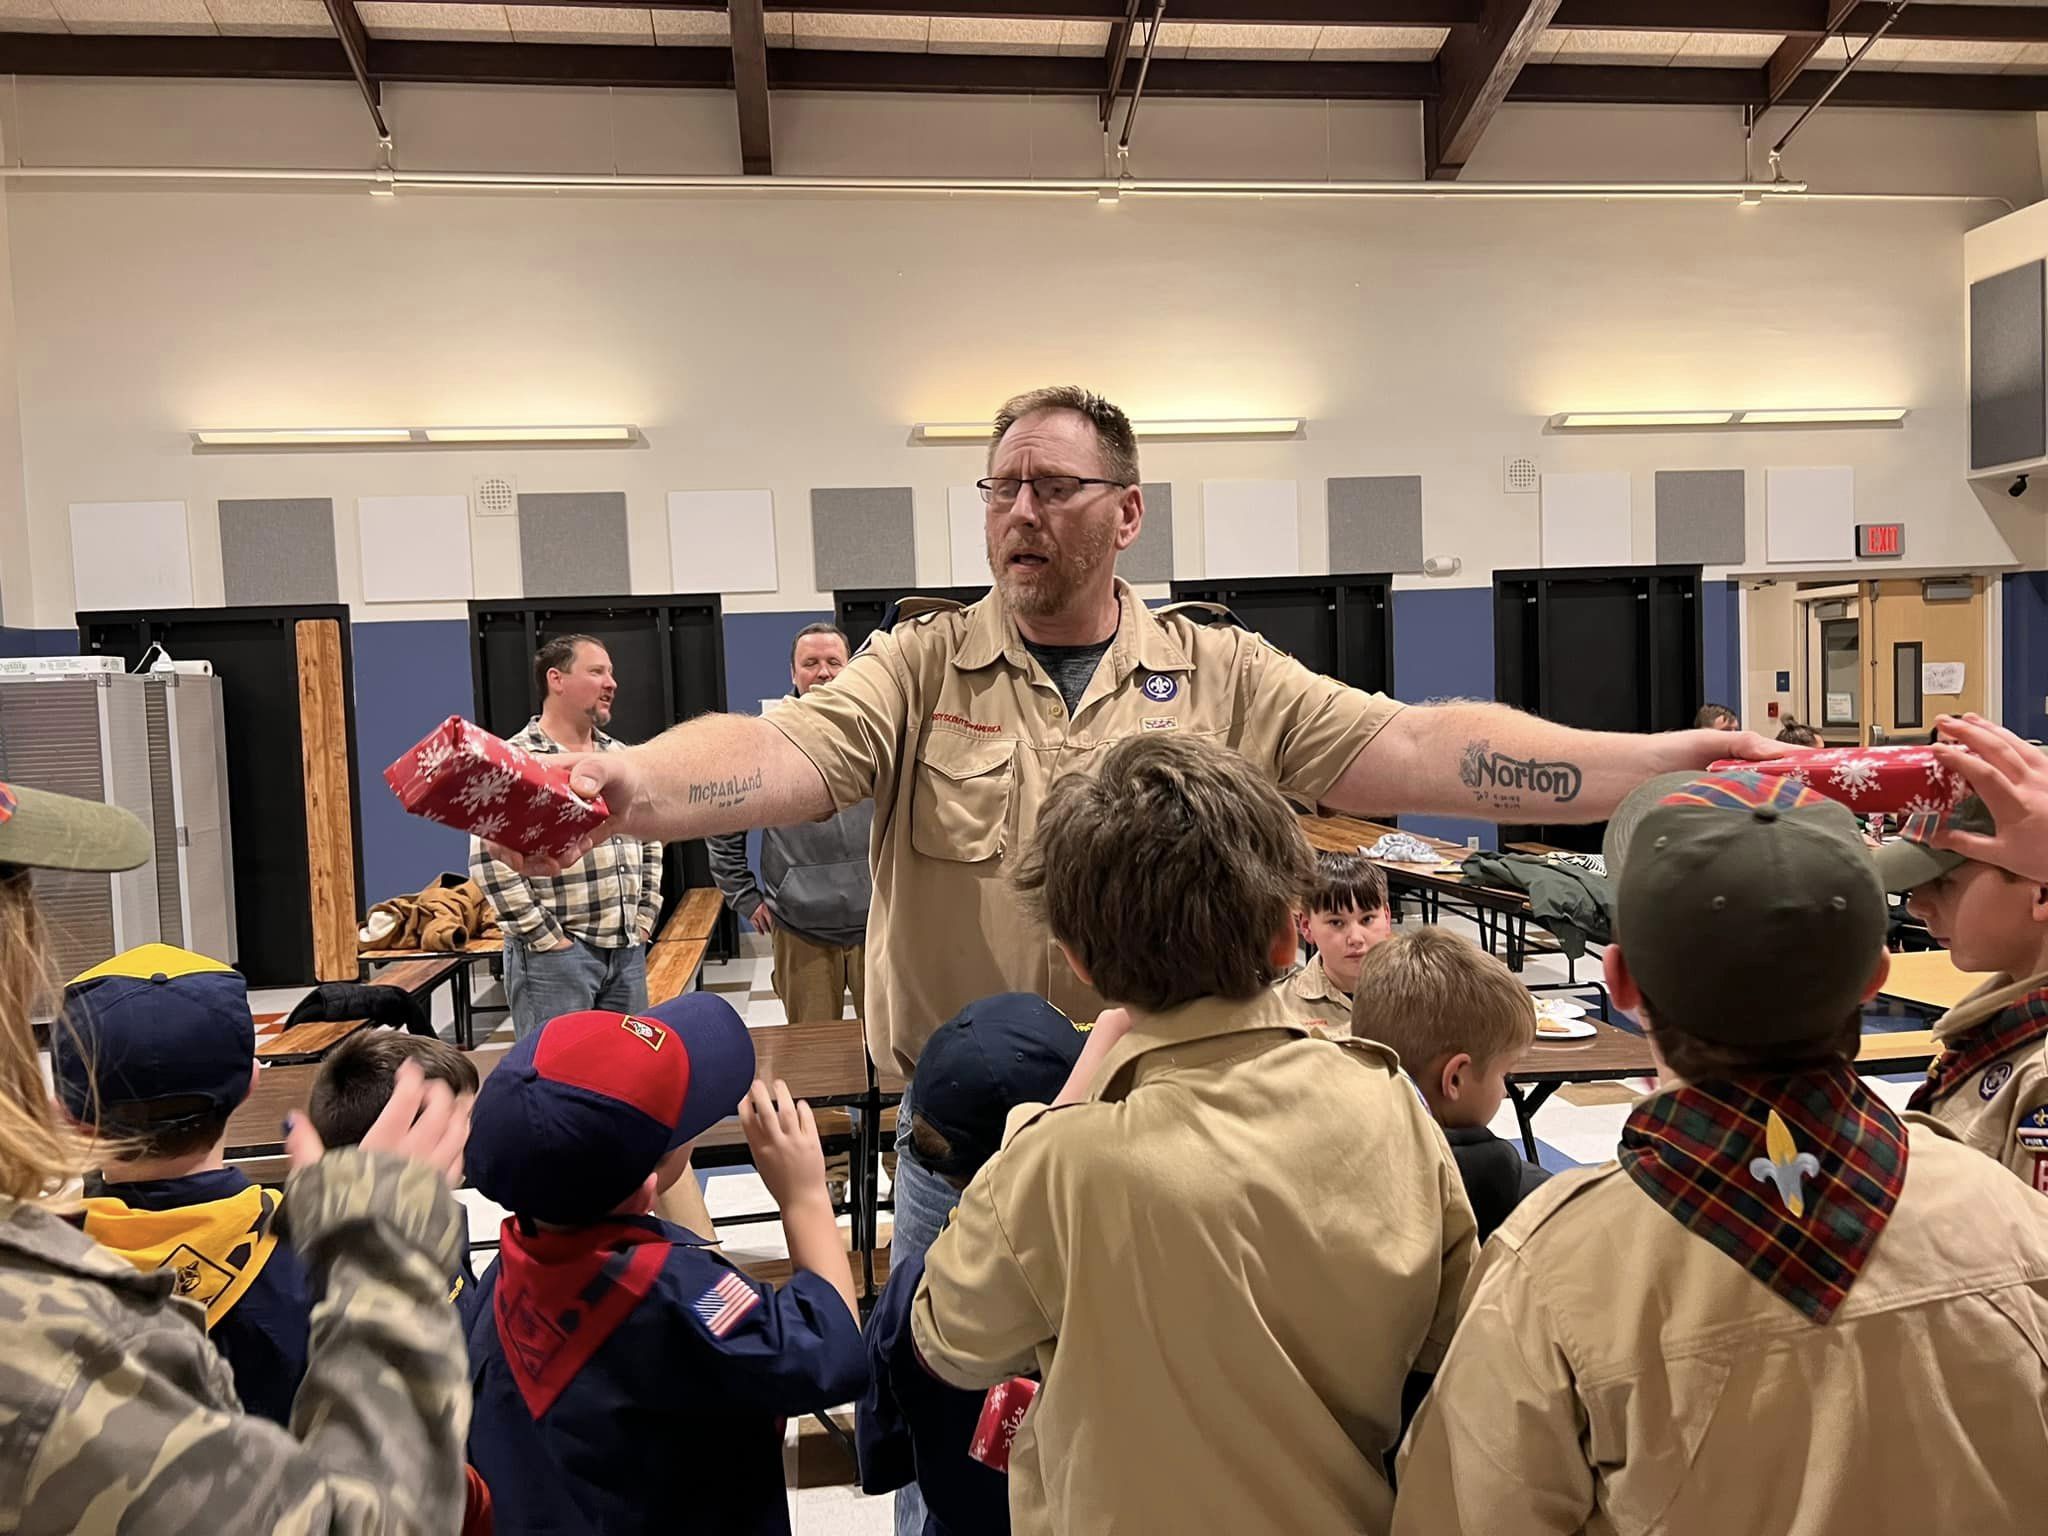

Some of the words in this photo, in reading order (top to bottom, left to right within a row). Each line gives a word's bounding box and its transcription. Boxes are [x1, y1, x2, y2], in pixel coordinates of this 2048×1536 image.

[1868, 527, 1898, 553] EXIT
[974, 724, 1002, 733] AMERICA
[1477, 751, 1583, 803] Norton
